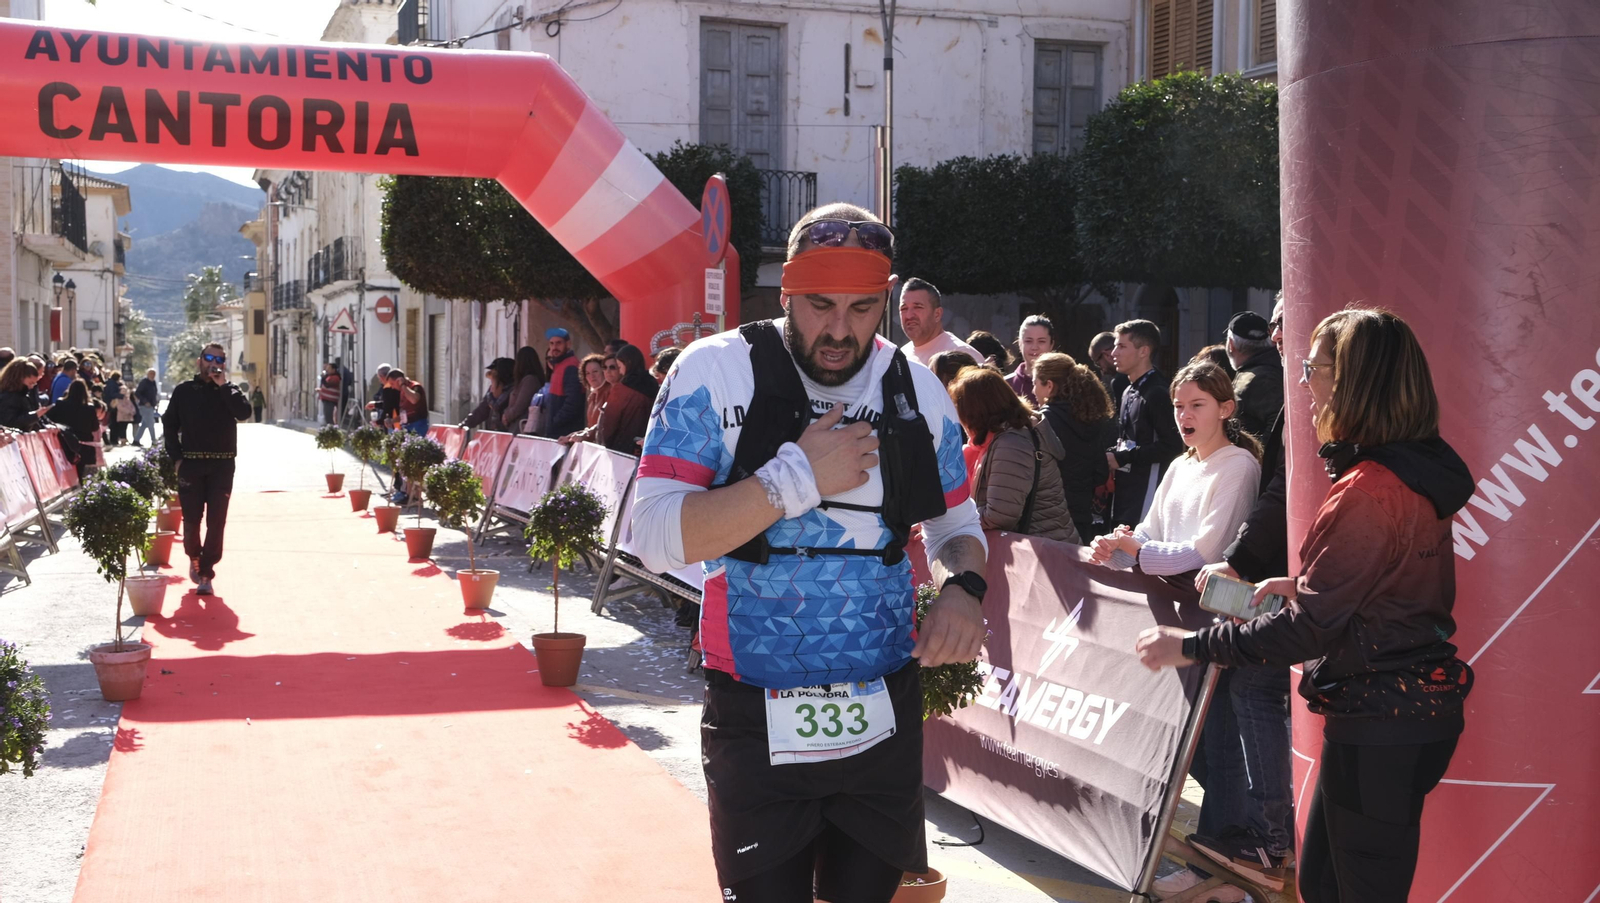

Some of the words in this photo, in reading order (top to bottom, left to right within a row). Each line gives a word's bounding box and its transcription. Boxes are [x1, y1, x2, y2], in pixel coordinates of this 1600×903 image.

[25, 30, 433, 85] AYUNTAMIENTO
[37, 81, 420, 157] CANTORIA
[1451, 346, 1600, 562] www.te
[780, 690, 795, 698] LA
[795, 702, 869, 738] 333
[979, 734, 1060, 779] www.teamergy.es
